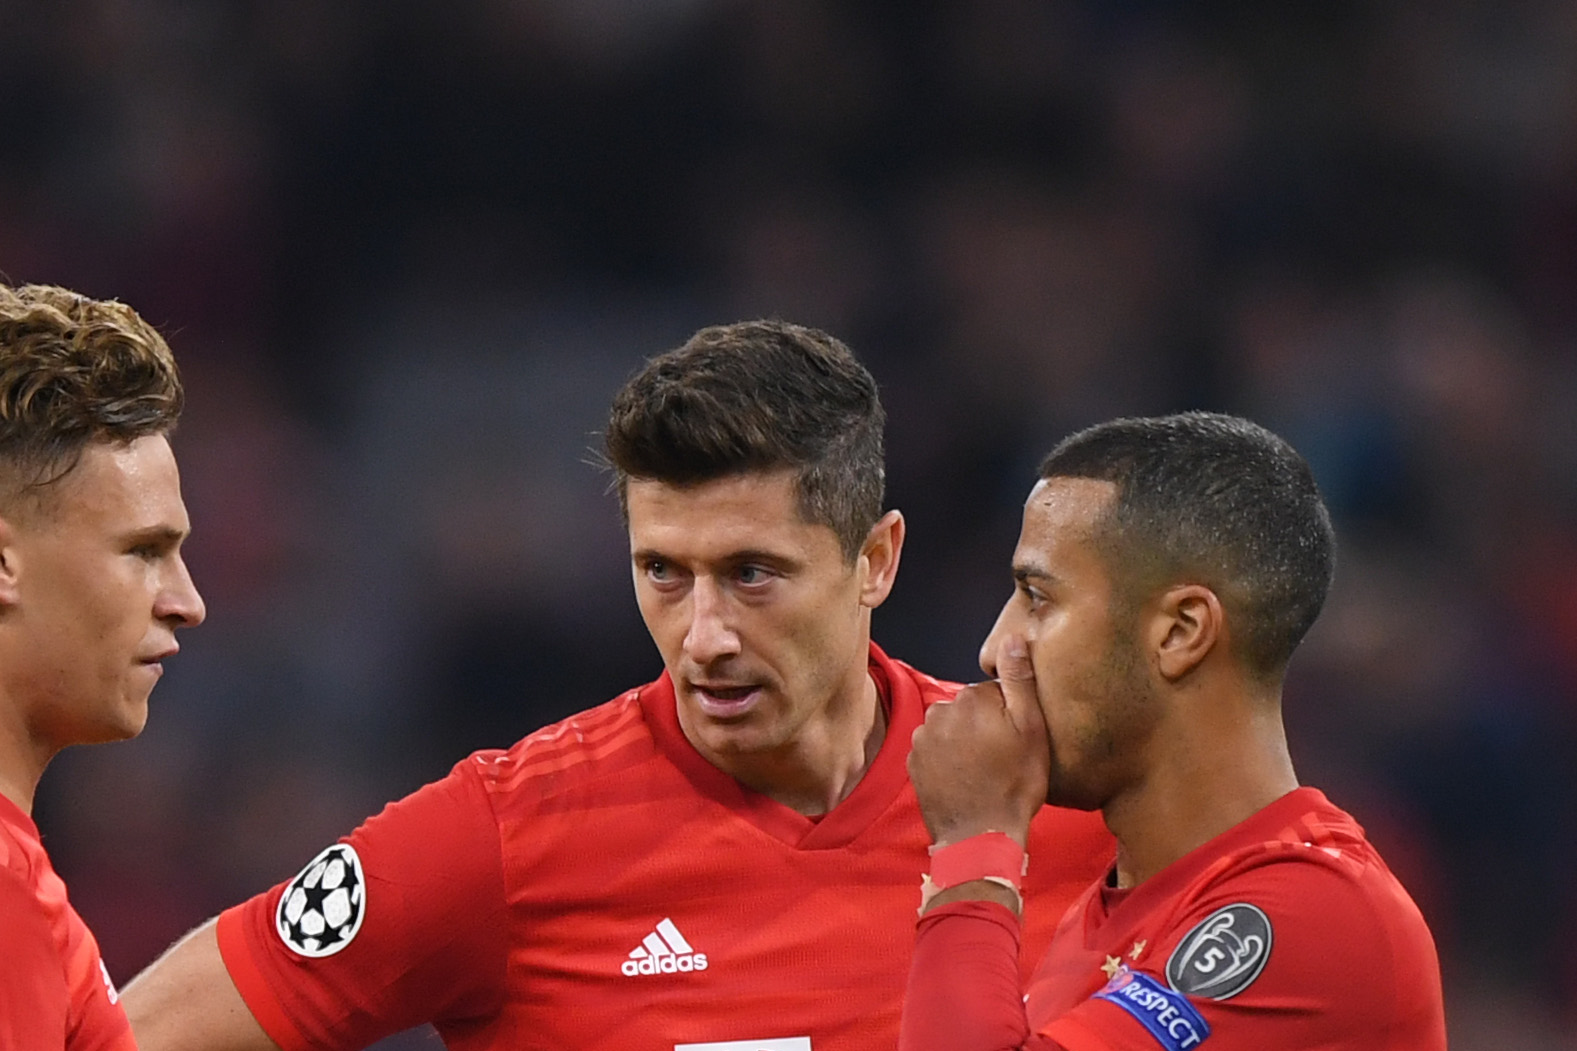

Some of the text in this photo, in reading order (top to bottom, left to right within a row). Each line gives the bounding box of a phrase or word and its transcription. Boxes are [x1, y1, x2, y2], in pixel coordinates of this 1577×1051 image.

[621, 952, 709, 977] adidas
[1193, 946, 1226, 973] 5
[1119, 981, 1201, 1049] RESPECT
